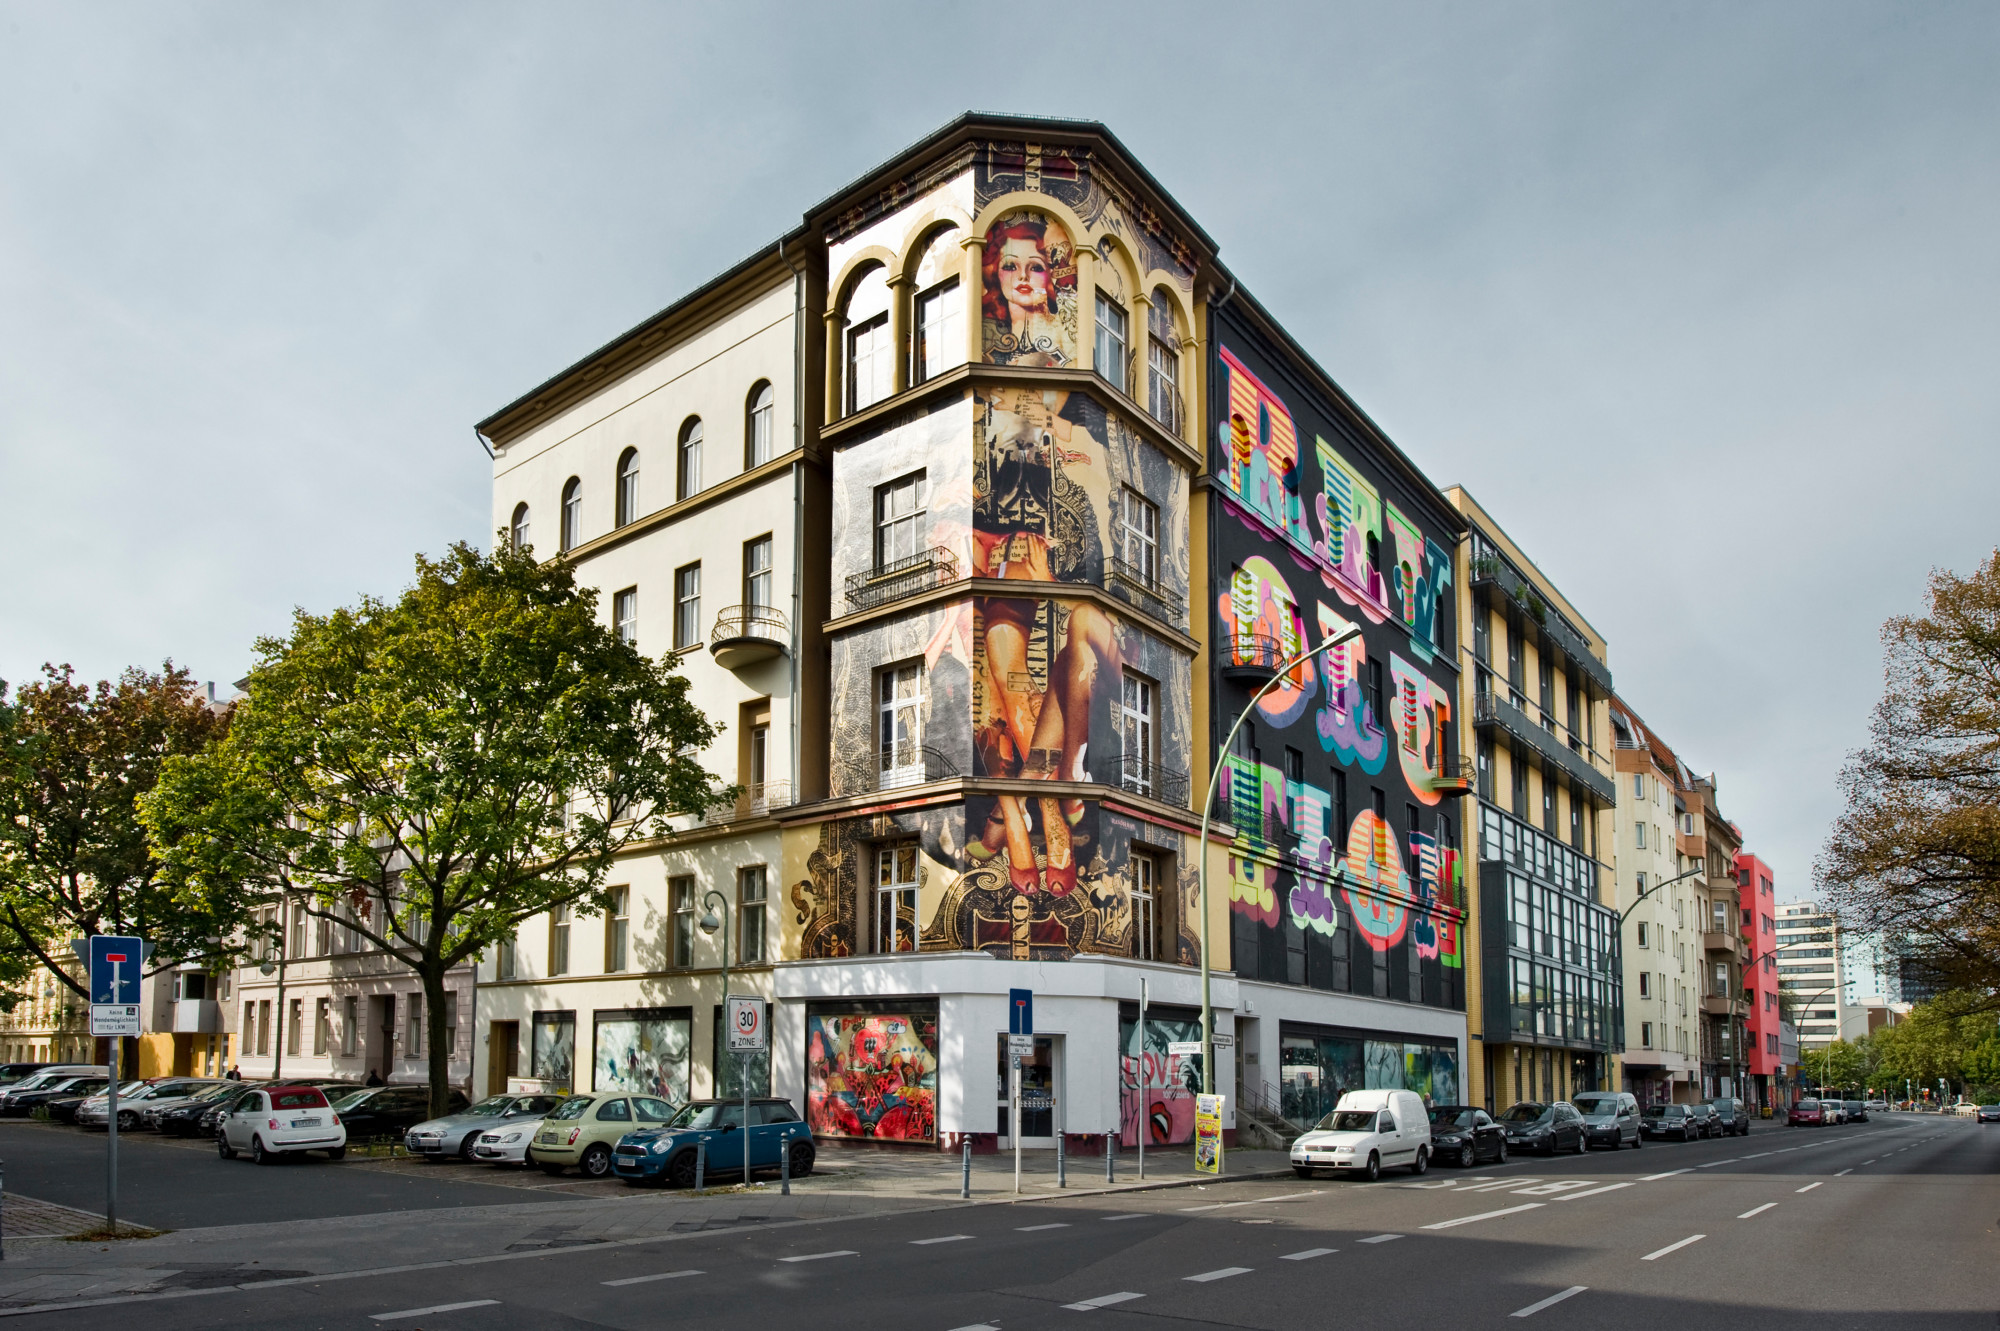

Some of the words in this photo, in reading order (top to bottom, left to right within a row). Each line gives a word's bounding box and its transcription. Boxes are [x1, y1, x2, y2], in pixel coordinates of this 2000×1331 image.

[740, 1011, 753, 1027] 30
[738, 1037, 756, 1047] ZONE
[1124, 1051, 1182, 1086] LOVE
